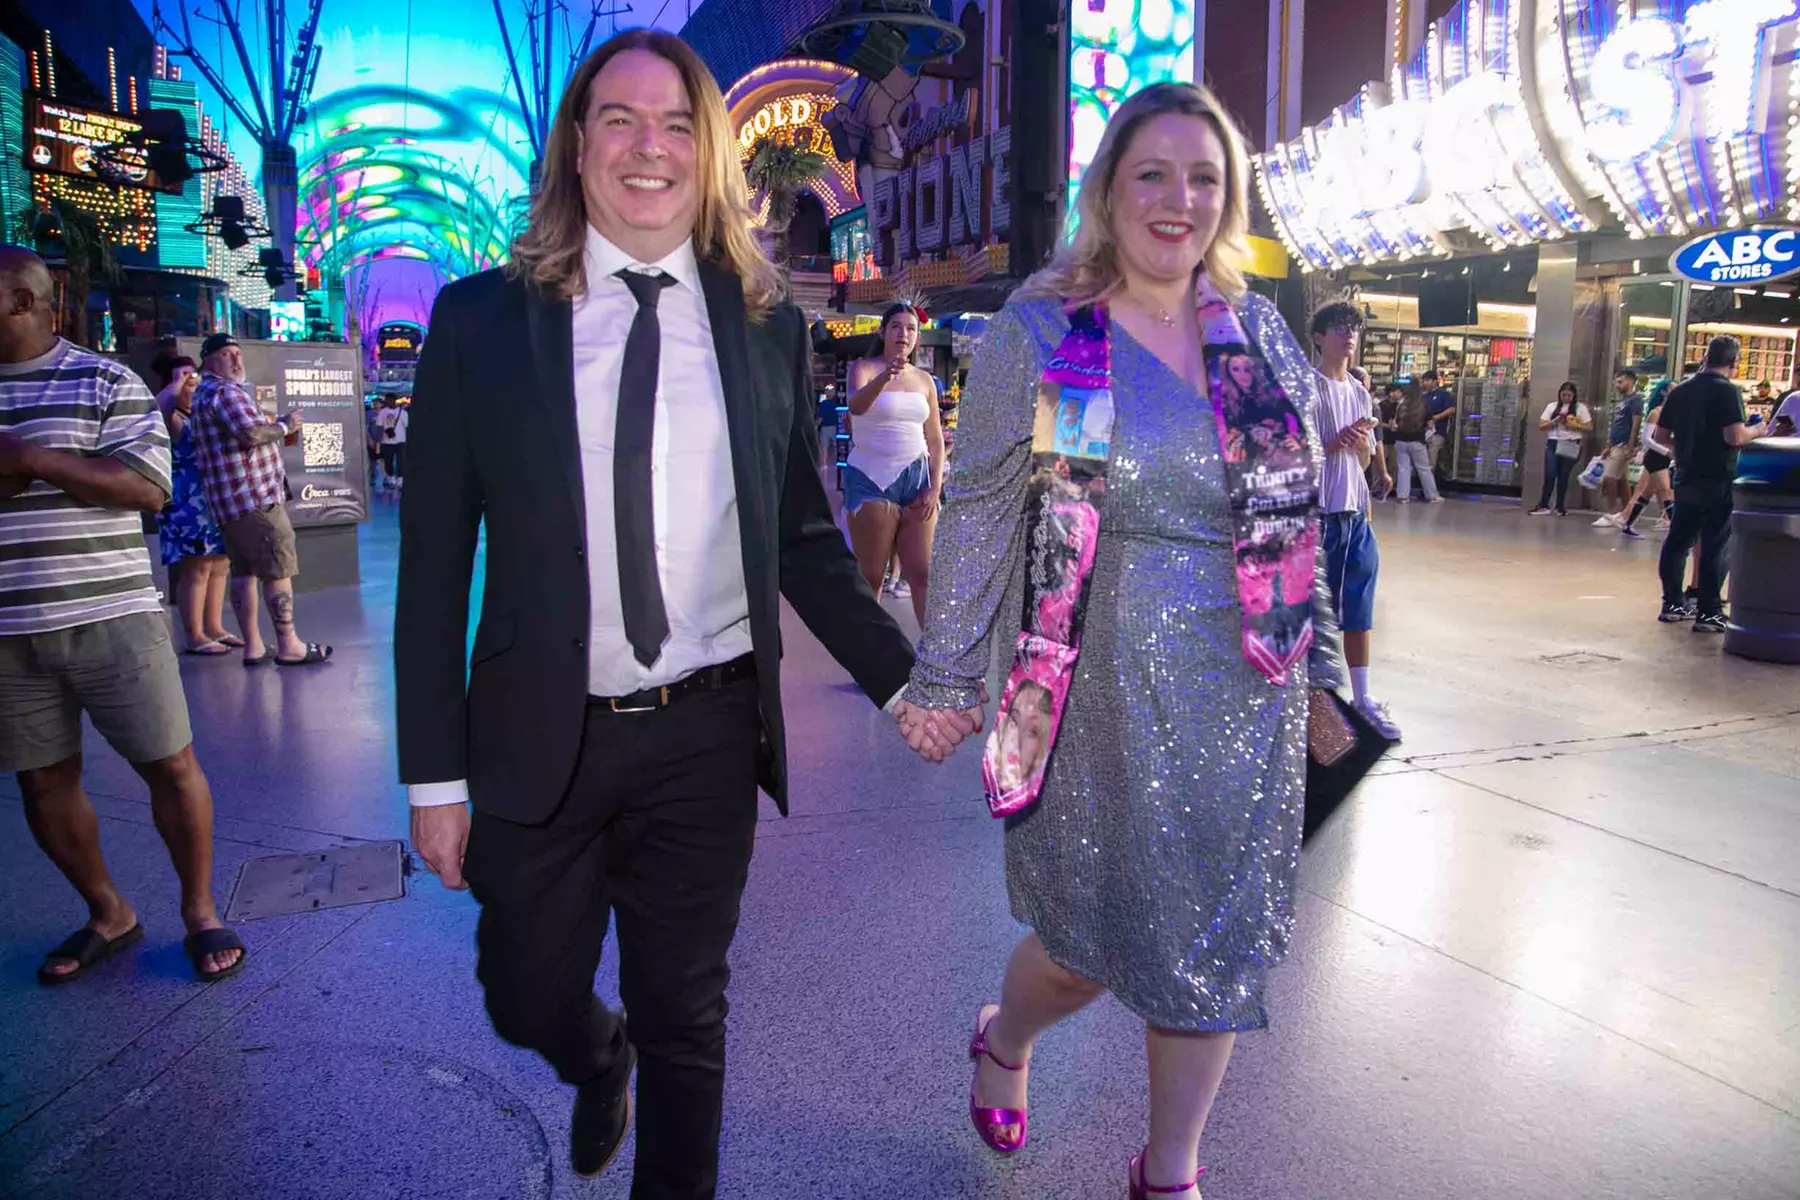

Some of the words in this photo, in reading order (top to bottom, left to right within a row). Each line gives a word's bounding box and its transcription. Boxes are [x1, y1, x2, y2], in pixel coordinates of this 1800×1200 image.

[58, 118, 71, 132] 12
[72, 121, 105, 139] LARGE
[1691, 230, 1796, 269] ABC
[1710, 263, 1772, 281] STORES
[285, 369, 320, 380] WORLD'S
[320, 370, 353, 381] LARGEST
[285, 381, 354, 396] SPORTSBOOK
[301, 484, 330, 501] Circa
